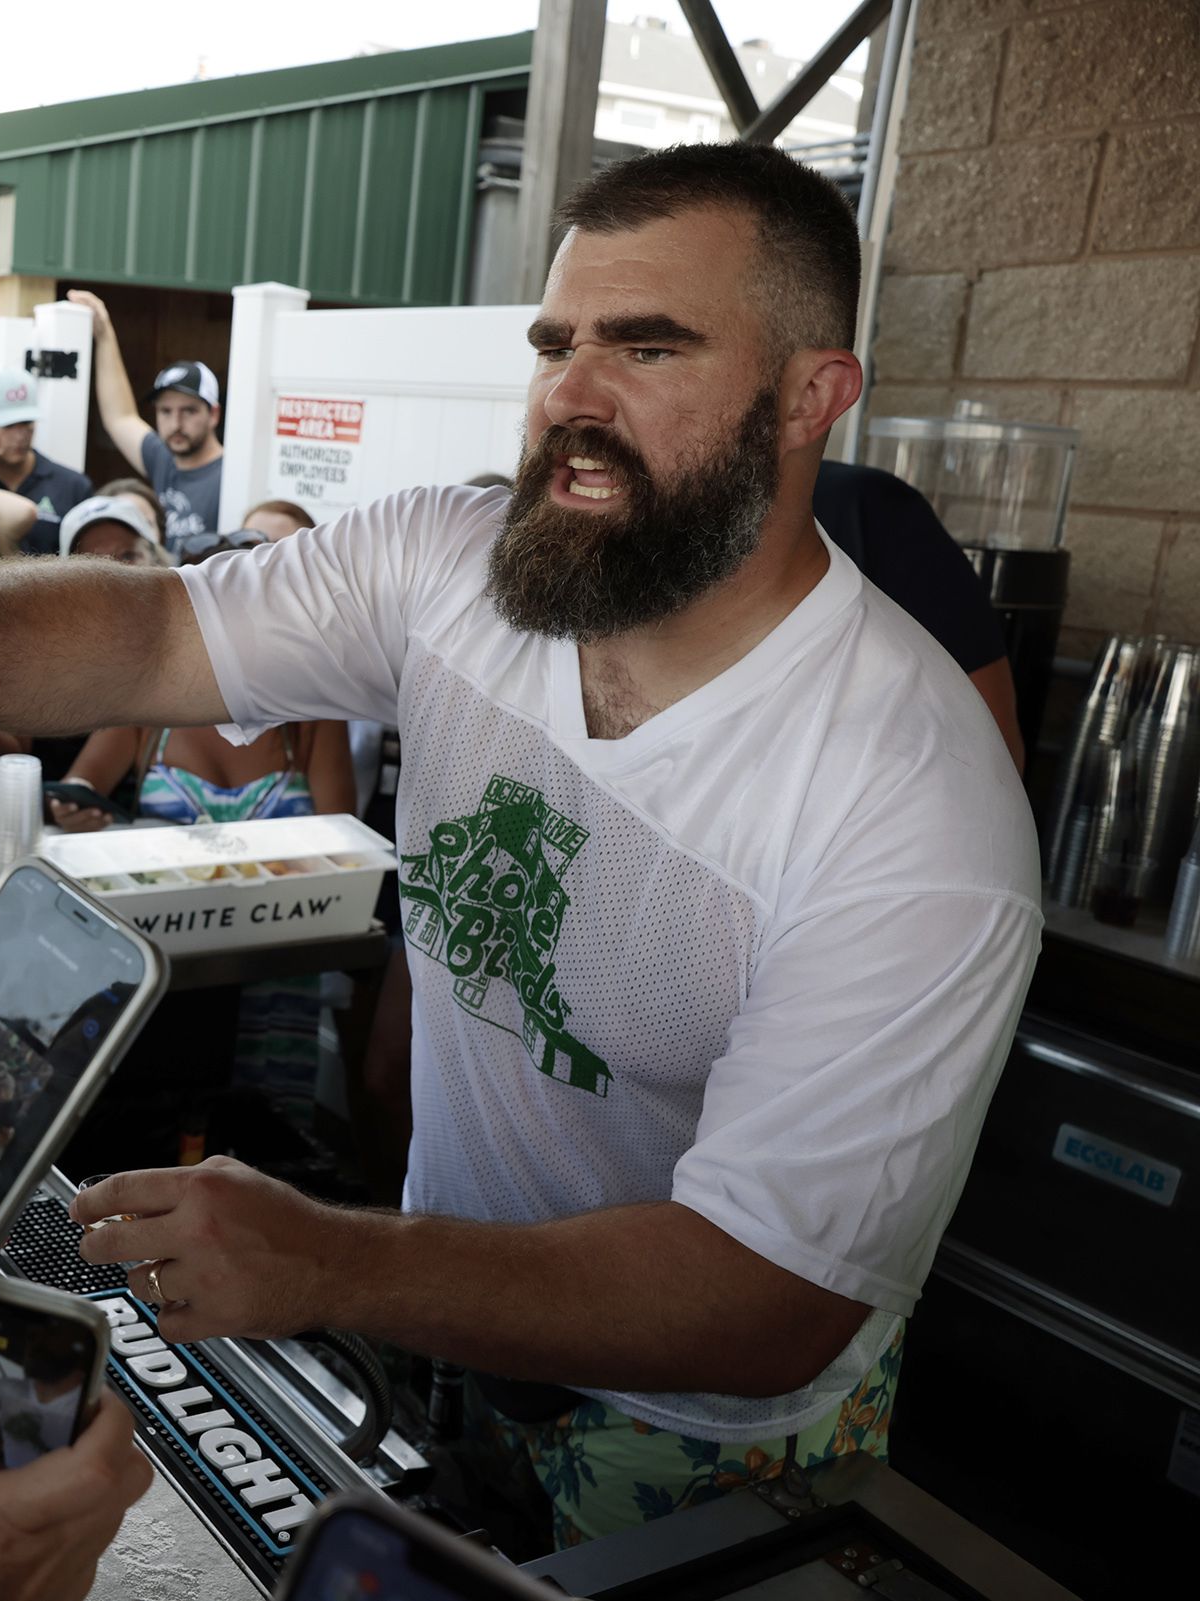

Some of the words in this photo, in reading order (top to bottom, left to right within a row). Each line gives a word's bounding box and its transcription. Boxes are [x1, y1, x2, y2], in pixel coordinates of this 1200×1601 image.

[279, 400, 363, 422] RESTRICTED
[297, 418, 335, 440] AREA
[280, 444, 353, 465] AUTHORIZED
[279, 461, 347, 483] EMPLOYEES
[295, 480, 324, 498] ONLY
[133, 906, 236, 934] WHITE
[249, 895, 333, 924] CLAW
[1064, 1136, 1167, 1193] ECOLAB
[94, 1296, 189, 1388] BUD
[157, 1385, 318, 1534] LIGHT
